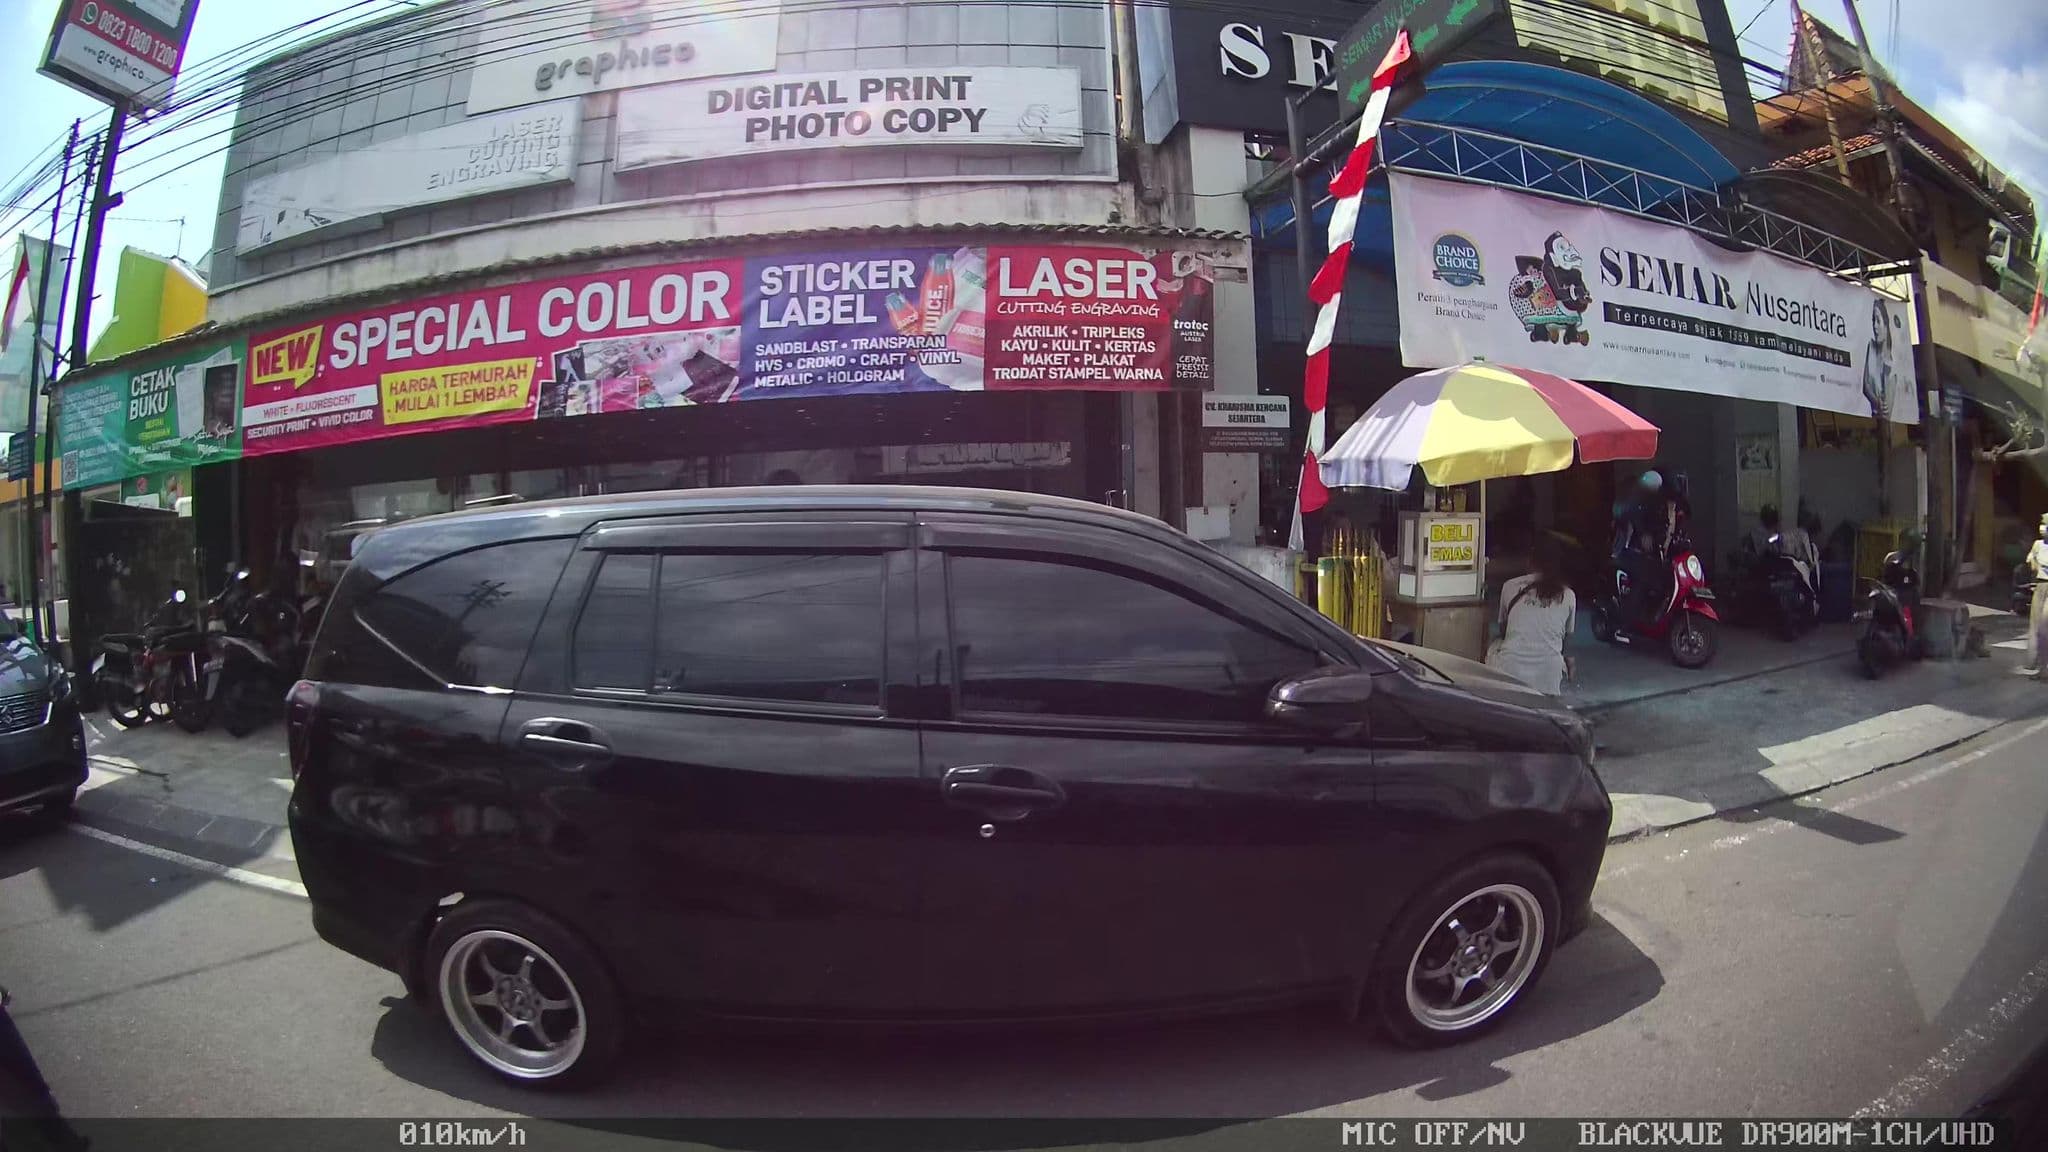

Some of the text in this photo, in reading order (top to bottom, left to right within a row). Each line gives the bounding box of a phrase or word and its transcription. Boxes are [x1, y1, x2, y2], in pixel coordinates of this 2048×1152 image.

[126, 25, 152, 54] 1800
[152, 40, 178, 69] 1200
[535, 40, 696, 91] graphico
[707, 76, 972, 114] DIGITAL PRINT
[488, 113, 564, 143] LASER
[745, 107, 987, 143] PHOTO COPY
[469, 135, 561, 164] CUTTING
[426, 152, 562, 190] ENGRAVING
[1436, 244, 1476, 258] BRAND
[1436, 256, 1479, 270] CHOICE
[760, 259, 916, 295] STICKER
[1000, 257, 1158, 300] LASER
[1599, 246, 1847, 338] SEMAR Nusantara
[329, 270, 730, 369] SPECIAL COLOR
[759, 294, 877, 329] LABEL
[997, 301, 1160, 318] CUTTING ENGRAVING
[1615, 308, 1688, 332] Terpercaya
[1694, 322, 1723, 339] sejak
[756, 335, 945, 356] SANDBLAST TRANSPARAN
[1001, 340, 1156, 353] KAYU KULIT KERTAS
[1013, 325, 1145, 339] AKRILIK TRIPLEKS
[256, 333, 316, 378] NEW
[755, 351, 961, 372] HVS CROMO CRAFT VINYL
[1023, 353, 1136, 366] MAKET PLAKAT
[131, 365, 176, 397] CETAK
[390, 363, 528, 396] HARGA TERMURAH
[754, 369, 905, 388] METALIC HOLOGRAM
[992, 368, 1163, 381] TRODAT STAMPEL WARNA
[1176, 371, 1210, 379] DETAIL
[129, 390, 169, 421] BUKU
[263, 405, 288, 418] WHITE
[395, 383, 519, 413] MULAI 1 LEMBAR
[247, 408, 373, 439] SECURITY PRINT VIVID COLOR
[1430, 524, 1473, 543] BELI
[1430, 547, 1473, 562] EMAS
